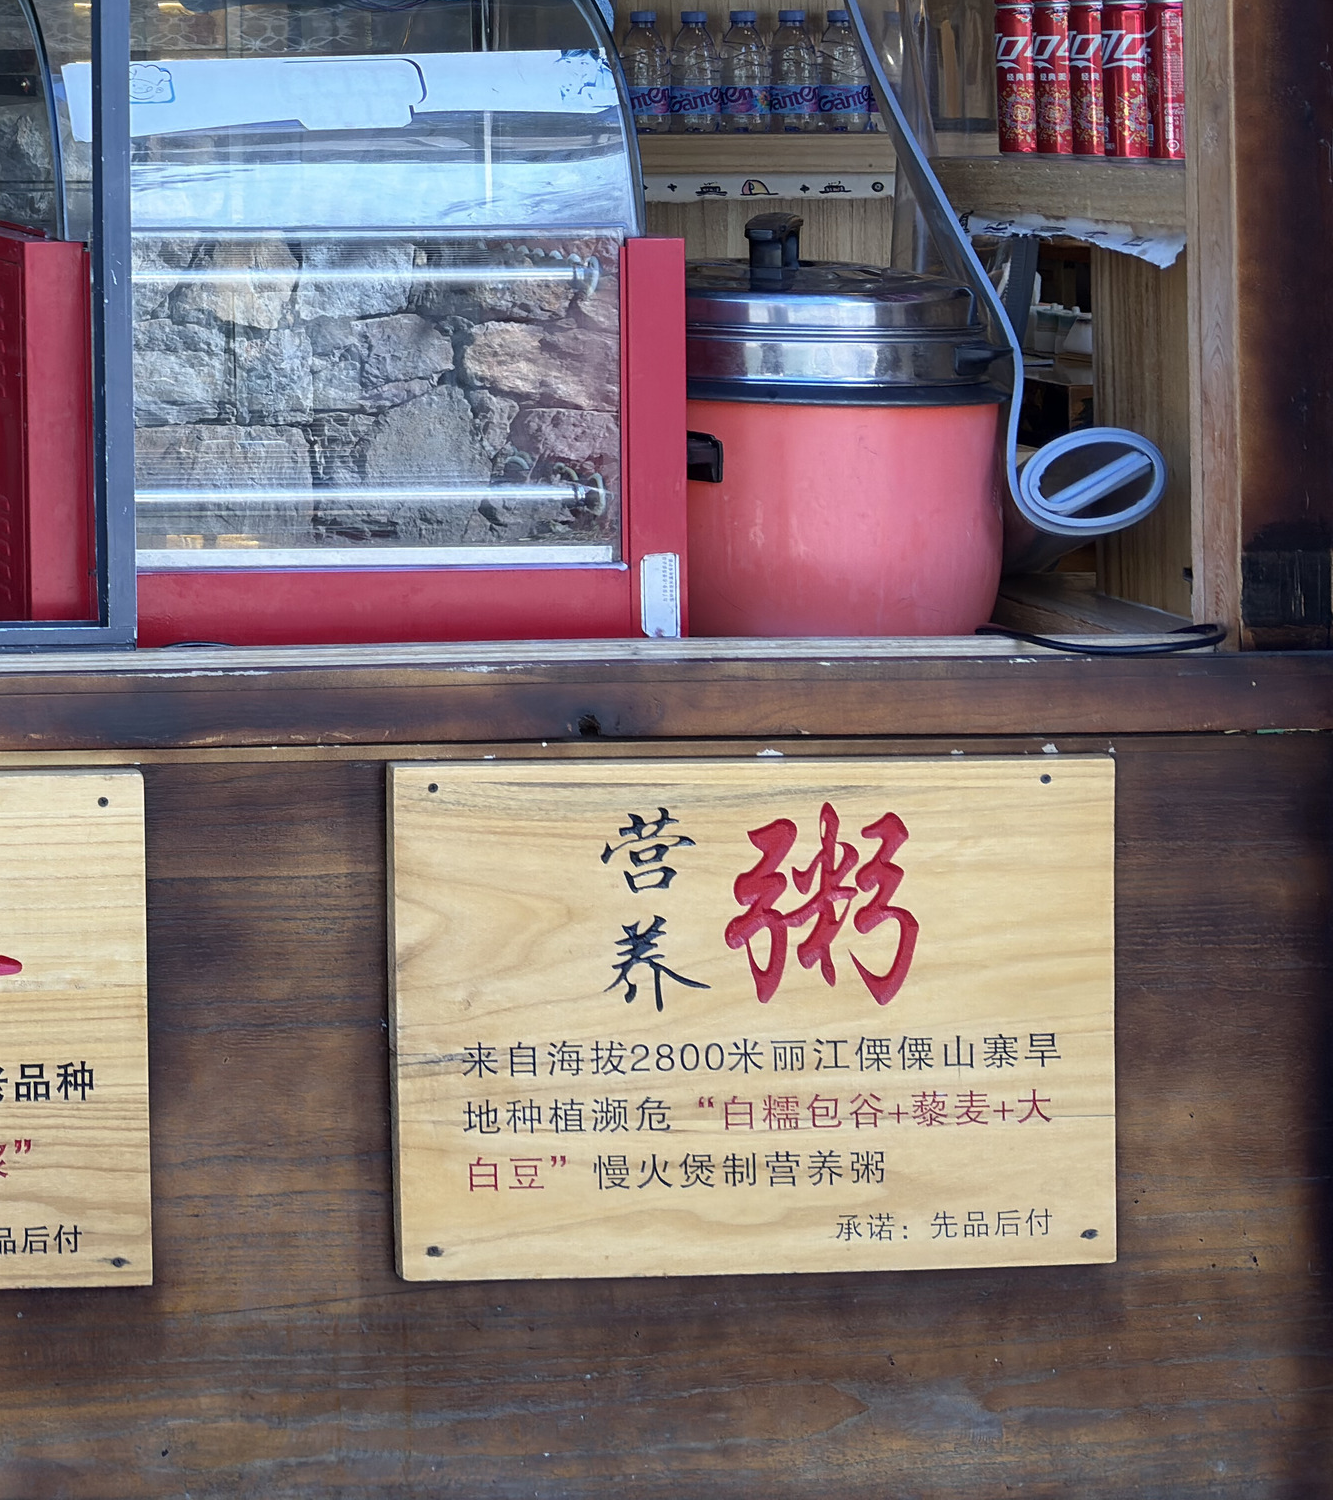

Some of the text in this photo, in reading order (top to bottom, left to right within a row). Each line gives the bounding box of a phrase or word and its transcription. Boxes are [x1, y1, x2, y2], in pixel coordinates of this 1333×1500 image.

[724, 801, 921, 1007] 粥
[461, 1031, 1063, 1078] 来自海拔2800米丽江傈僳山寨旱
[835, 1207, 1054, 1242] 承诺：先品后付
